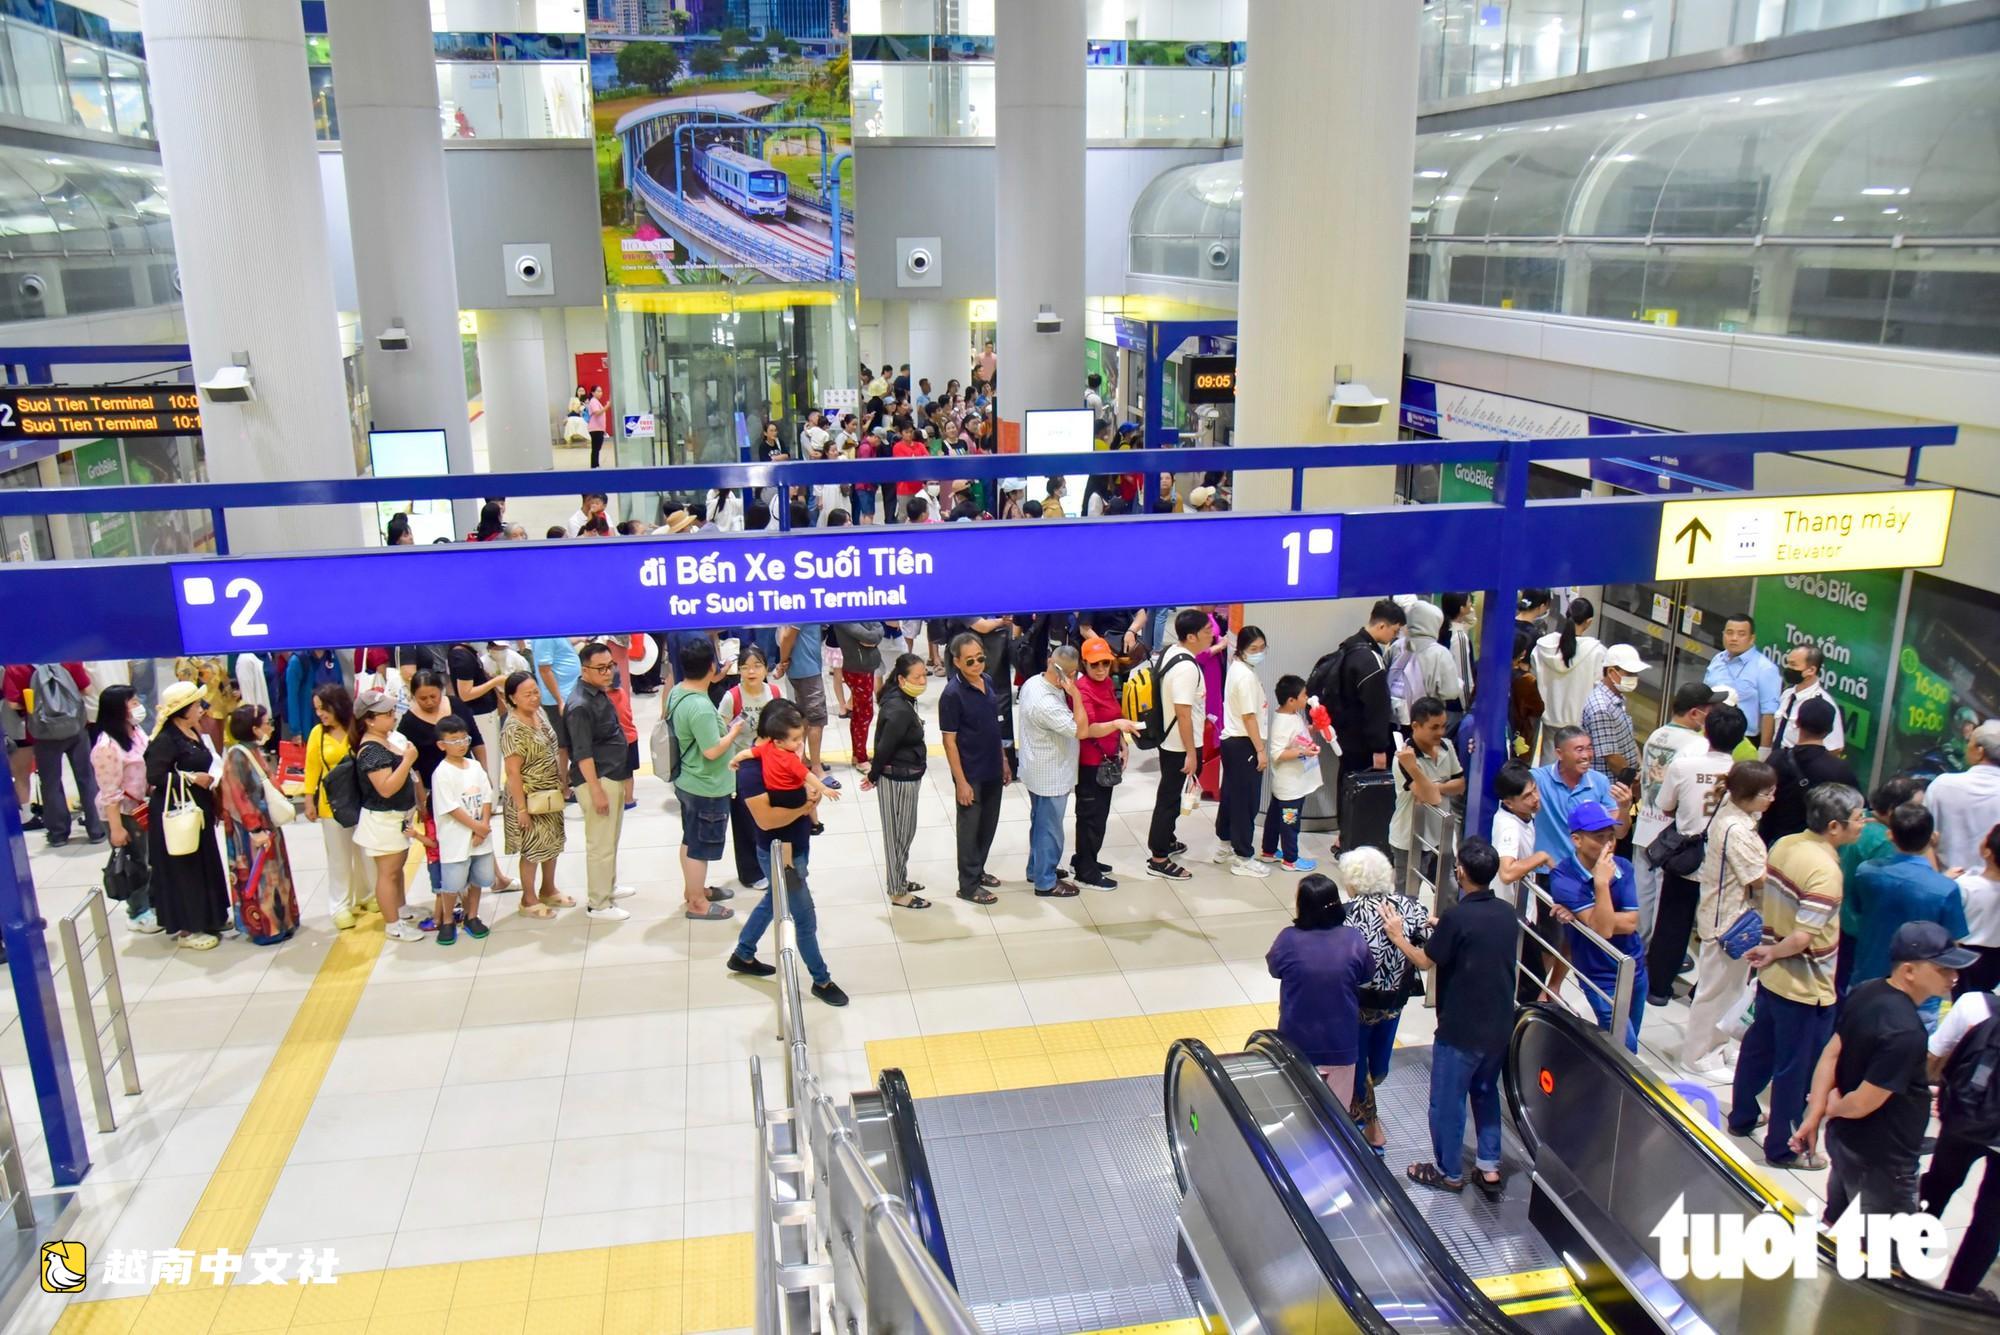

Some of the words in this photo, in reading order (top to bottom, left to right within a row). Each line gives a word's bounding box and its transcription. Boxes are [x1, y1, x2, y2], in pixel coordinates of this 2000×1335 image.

[1197, 374, 1231, 388] 09:05
[17, 398, 51, 412] Suoi
[54, 397, 87, 412] Tien
[90, 396, 154, 410] Terminal
[168, 395, 199, 409] 10:0
[22, 418, 56, 433] Suoi
[59, 417, 91, 432] Tien
[94, 416, 158, 431] Terminal
[172, 415, 201, 429] 10:1
[1455, 463, 1494, 490] GrabBike
[1783, 510, 1852, 536] Thang
[1861, 506, 1911, 534] máy
[639, 557, 667, 587] đi
[676, 551, 737, 585] Bến
[744, 552, 785, 582] Xe
[793, 546, 861, 580] Suối
[868, 547, 934, 577] Tiên
[1282, 531, 1301, 586] 1
[1777, 544, 1842, 561] Elevator
[225, 577, 269, 637] 2
[669, 595, 701, 615] for
[706, 591, 754, 614] Suoi
[758, 590, 806, 611] Tien
[811, 585, 907, 609] Terminal
[1784, 575, 1868, 612] GrabBike
[1696, 773, 1717, 784] BE
